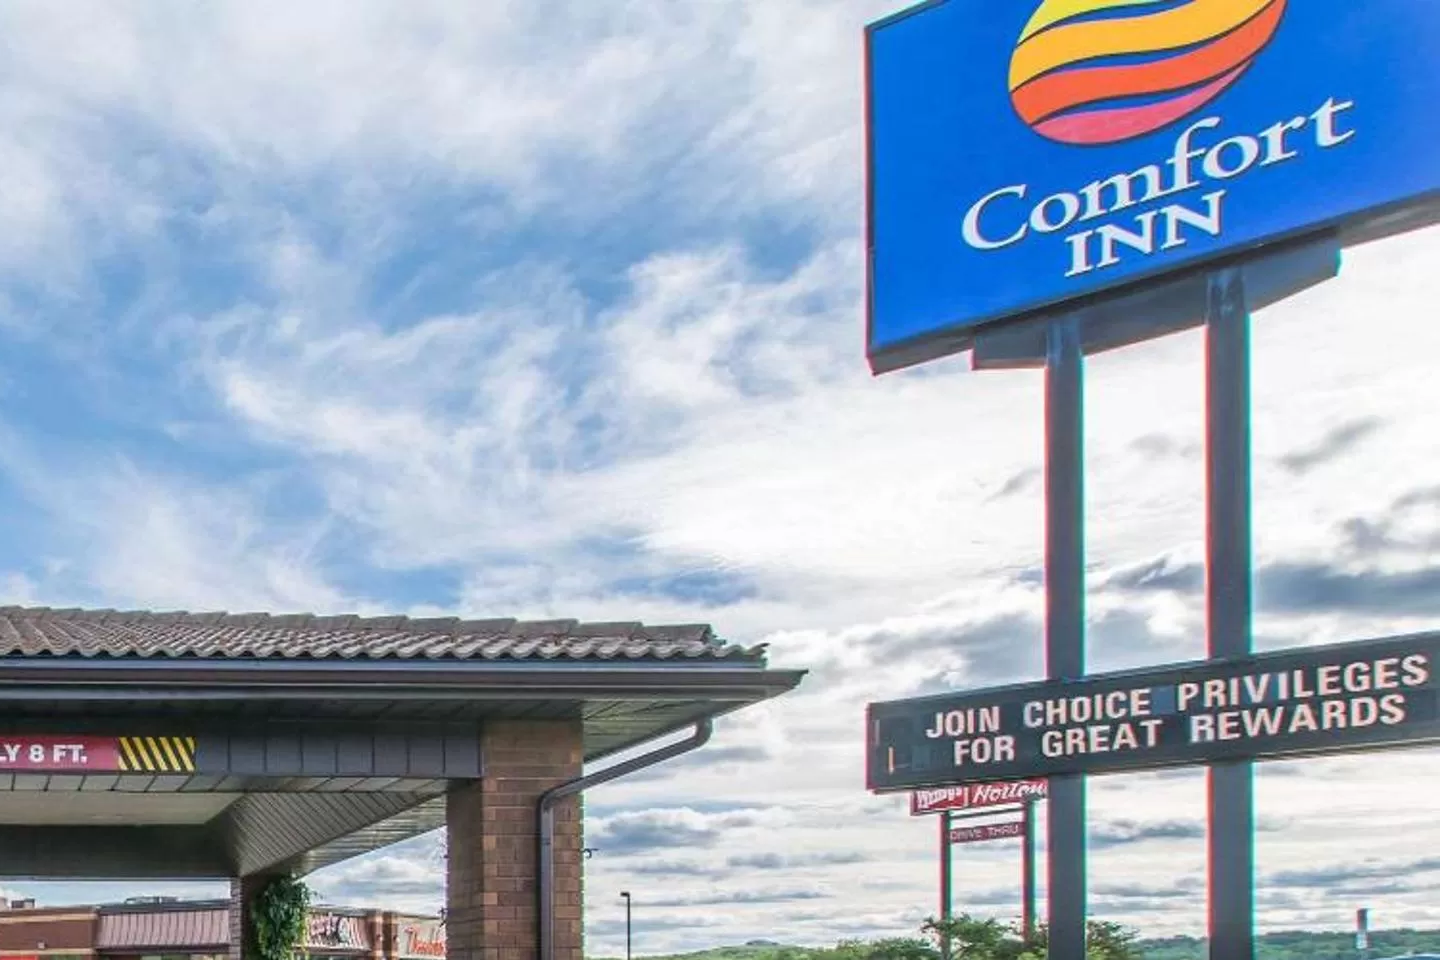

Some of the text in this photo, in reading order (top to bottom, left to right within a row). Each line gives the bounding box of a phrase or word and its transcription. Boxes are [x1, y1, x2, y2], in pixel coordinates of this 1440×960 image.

[962, 97, 1356, 250] Comfort
[1065, 190, 1226, 278] INN
[926, 654, 1429, 739] JOIN CHOICE PRIVILEGES
[953, 694, 1406, 766] FOR GREAT REWARDS
[29, 744, 45, 763] 8
[53, 744, 88, 763] FT.
[986, 824, 1019, 836] THRU
